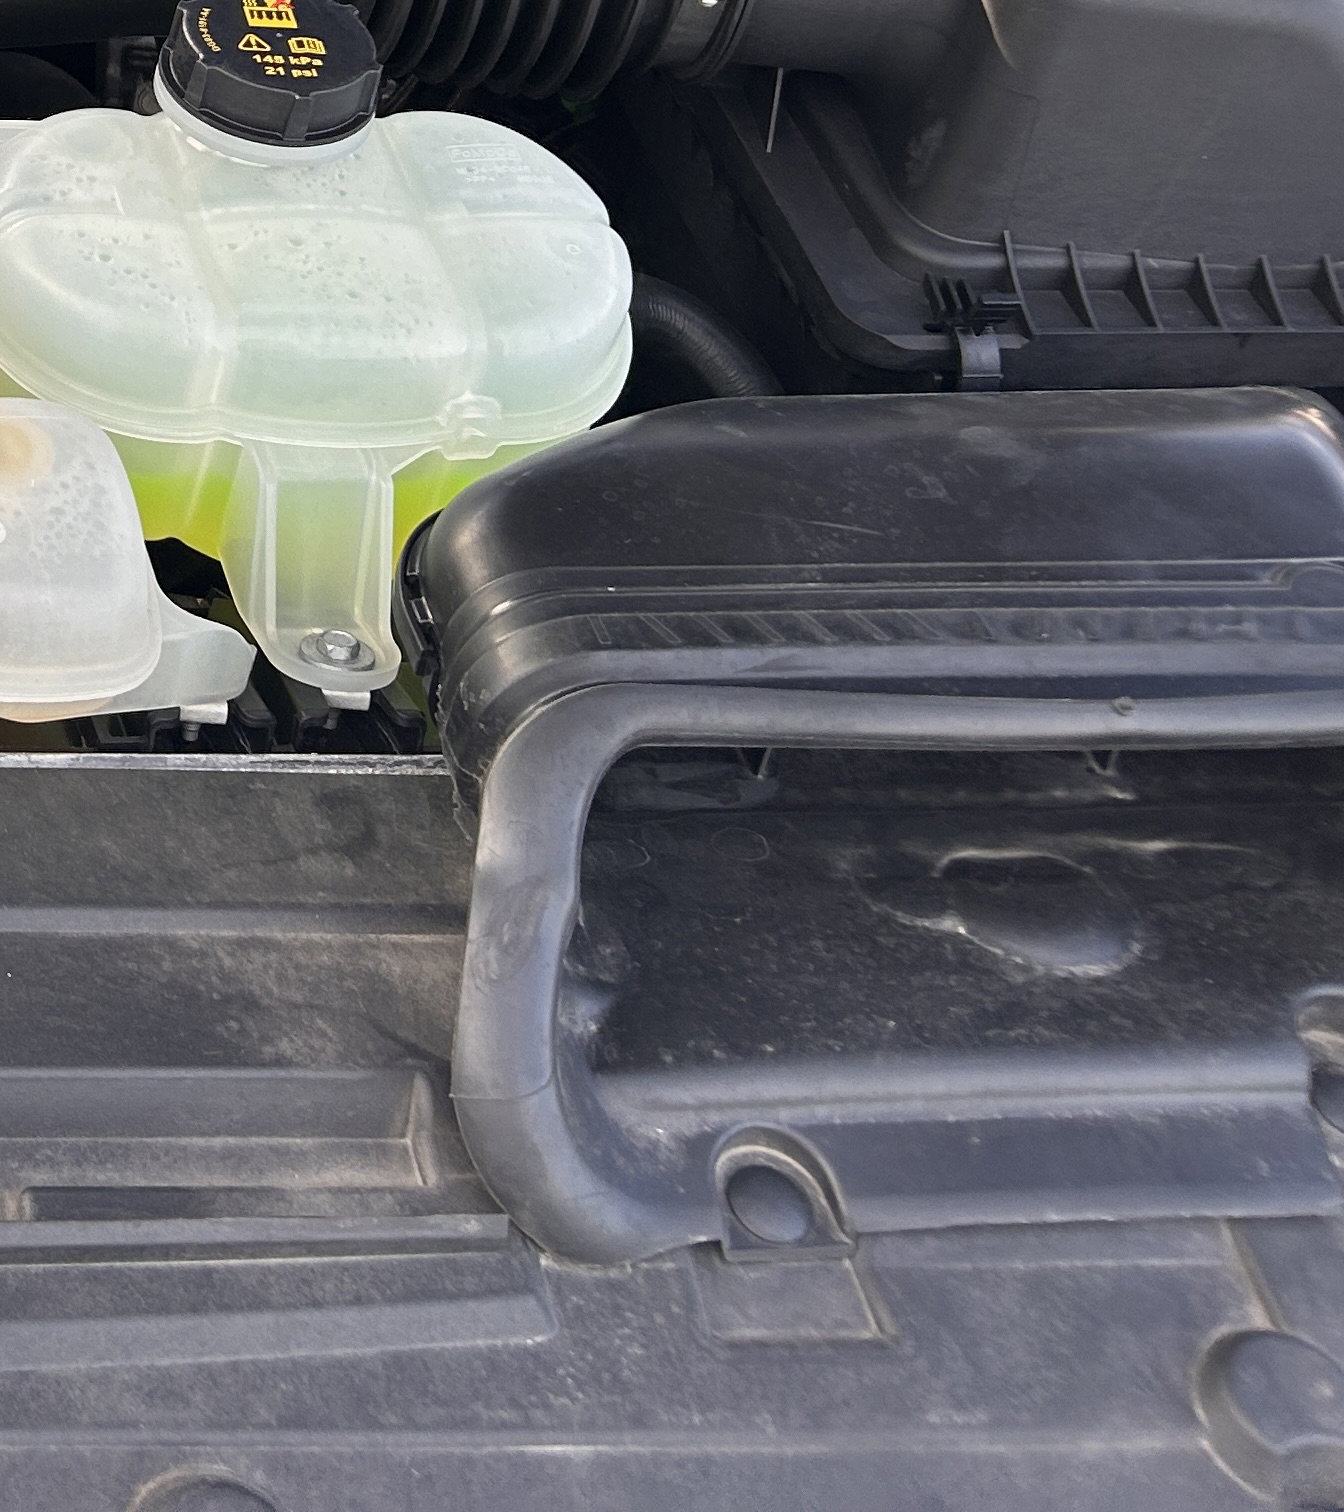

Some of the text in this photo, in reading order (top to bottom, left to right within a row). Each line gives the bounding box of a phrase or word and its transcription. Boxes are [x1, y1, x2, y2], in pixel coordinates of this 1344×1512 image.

[288, 55, 324, 67] kPa
[264, 65, 319, 79] 21 psi
